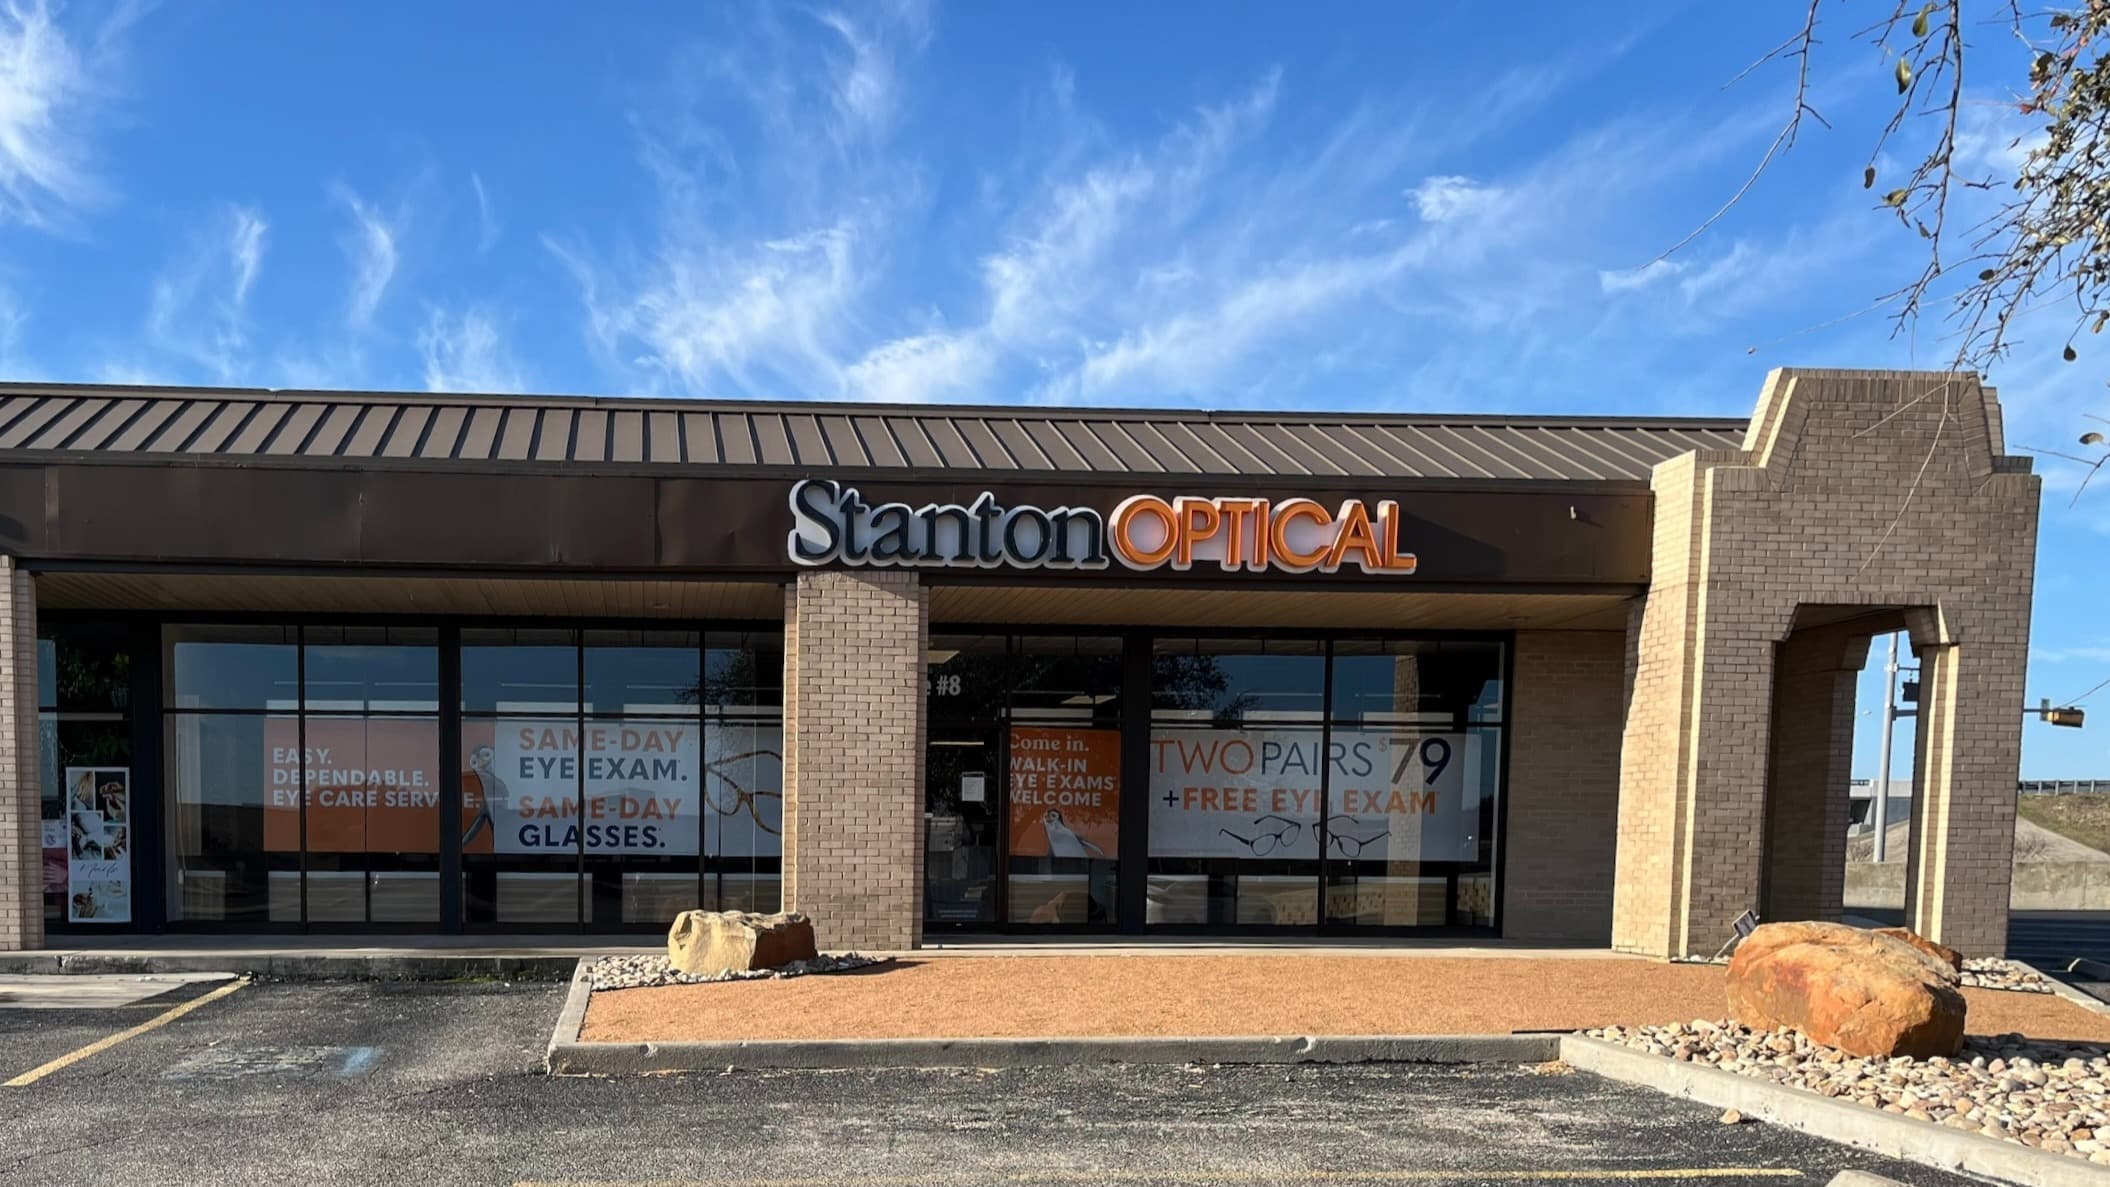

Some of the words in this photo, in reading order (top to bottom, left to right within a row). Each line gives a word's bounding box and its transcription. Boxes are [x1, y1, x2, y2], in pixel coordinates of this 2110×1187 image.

[789, 479, 1109, 567] Stanton
[1111, 495, 1417, 573] OPTICAL
[936, 675, 961, 696] #8
[519, 727, 684, 753] SAME-DAY
[1066, 736, 1089, 752] in.
[273, 747, 332, 764] EASY.
[1010, 757, 1087, 773] WALK-IN
[1377, 737, 1451, 785] $79
[273, 768, 429, 787] DEPENDABLE.
[520, 757, 574, 779] EYE
[319, 790, 377, 807] CARE
[519, 795, 682, 821] SAME-DAY
[1010, 790, 1102, 807] WELCOME
